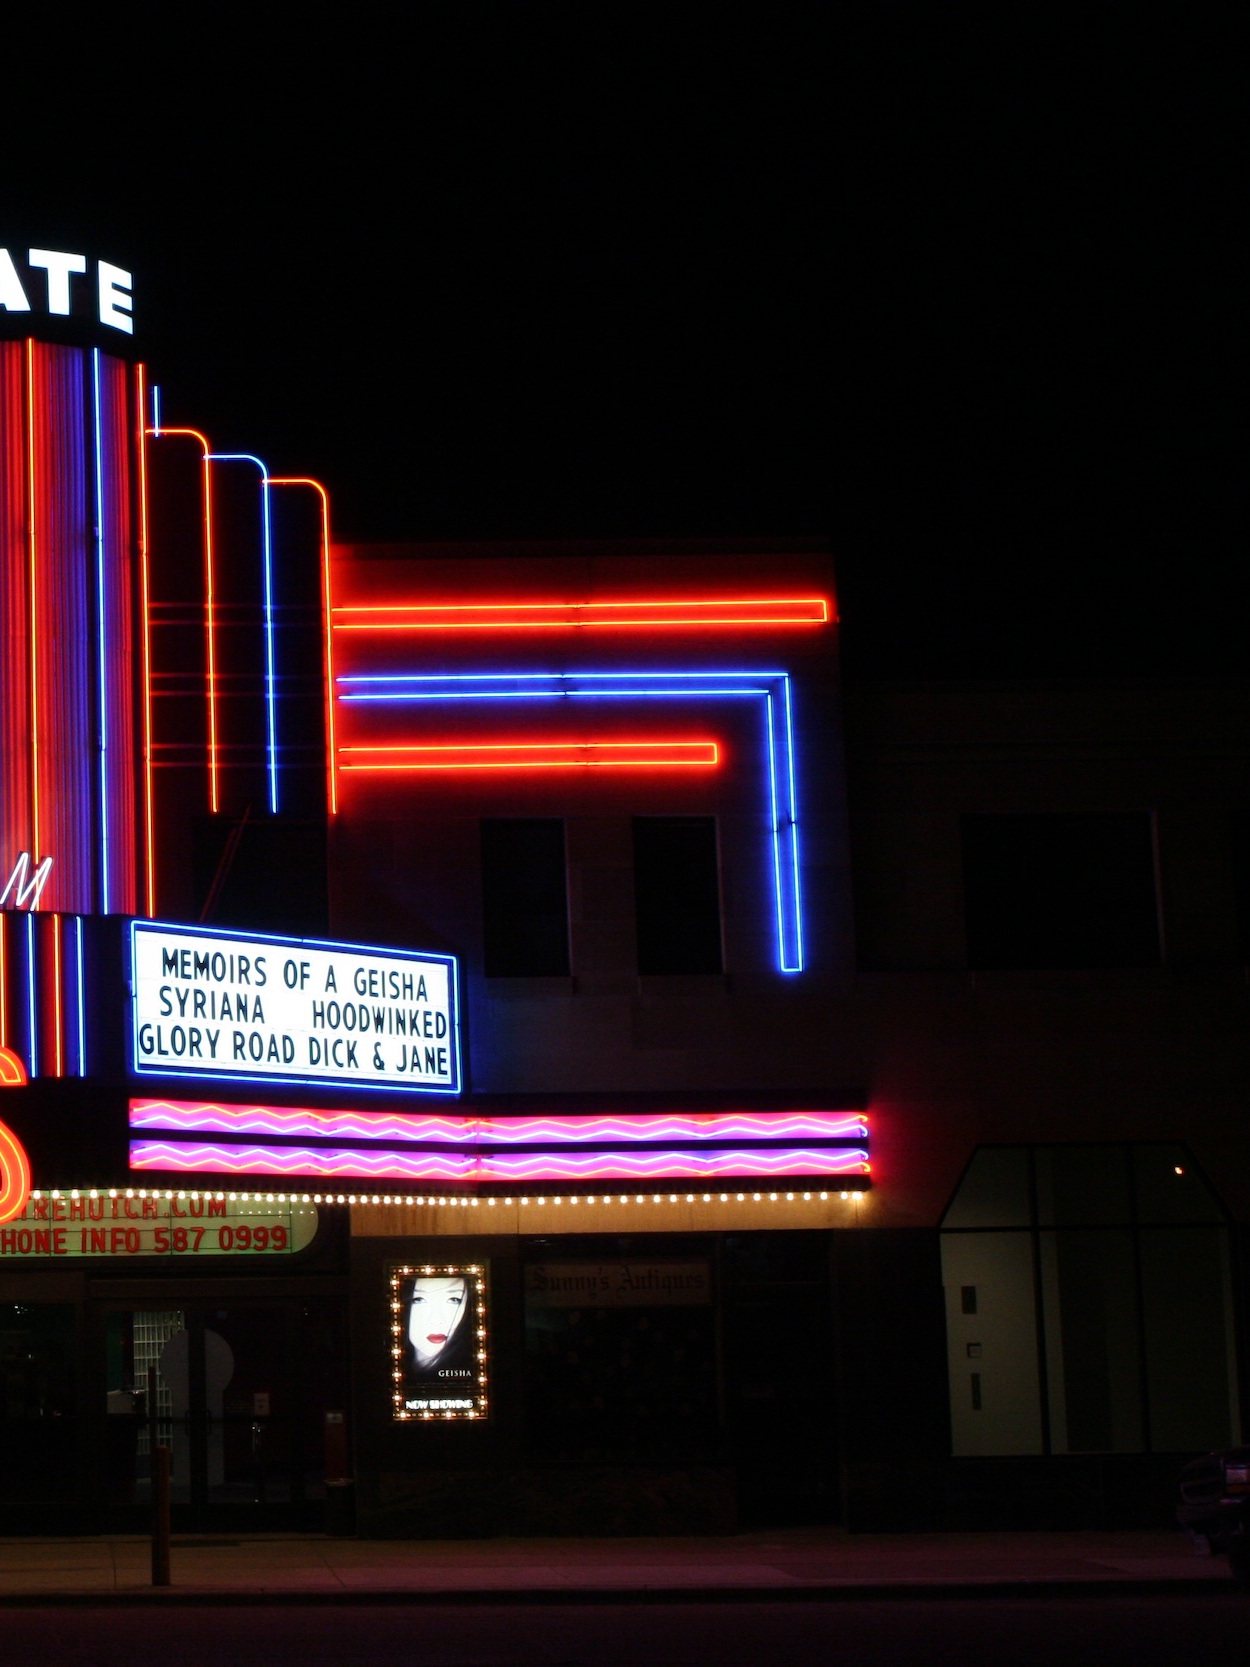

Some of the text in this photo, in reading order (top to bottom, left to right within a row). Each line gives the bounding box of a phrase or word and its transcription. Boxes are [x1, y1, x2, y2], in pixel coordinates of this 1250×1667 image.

[161, 947, 429, 1003] MEMOIRS OF A GEISHA
[158, 985, 447, 1039] SYRIANA HOODWINKED
[139, 1023, 448, 1075] GLORY ROAD DICK & JANE
[80, 1227, 141, 1254] INFO
[153, 1227, 207, 1253] 587
[217, 1225, 288, 1252] 0999
[529, 1263, 705, 1299] Sunny's Antiques
[438, 1369, 472, 1378] GEISHA
[405, 1399, 429, 1410] NOW
